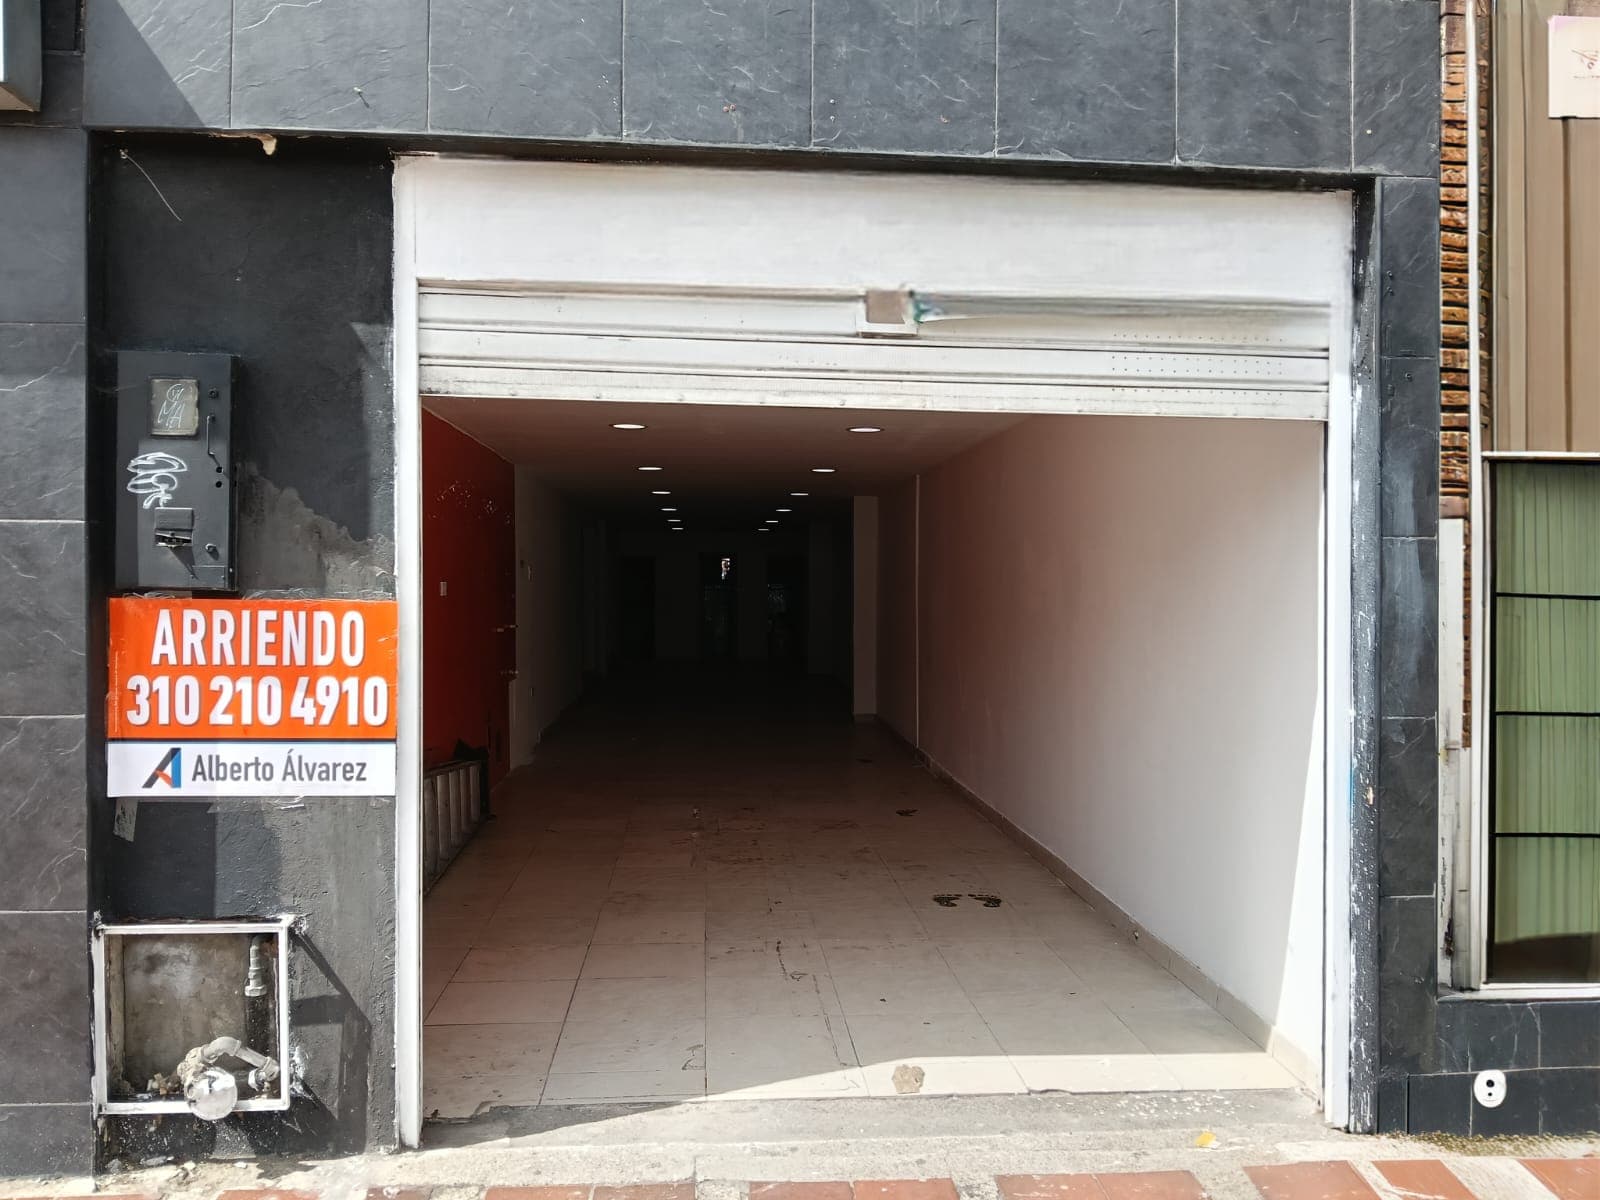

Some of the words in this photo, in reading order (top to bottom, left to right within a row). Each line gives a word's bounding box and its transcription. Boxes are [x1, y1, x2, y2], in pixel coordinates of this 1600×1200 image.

[151, 609, 365, 667] ARRIENDO
[126, 675, 200, 726] 310
[209, 675, 283, 726] 210
[290, 676, 389, 726] 4910
[191, 754, 274, 782] Alberto
[282, 748, 367, 782] Álvarez
